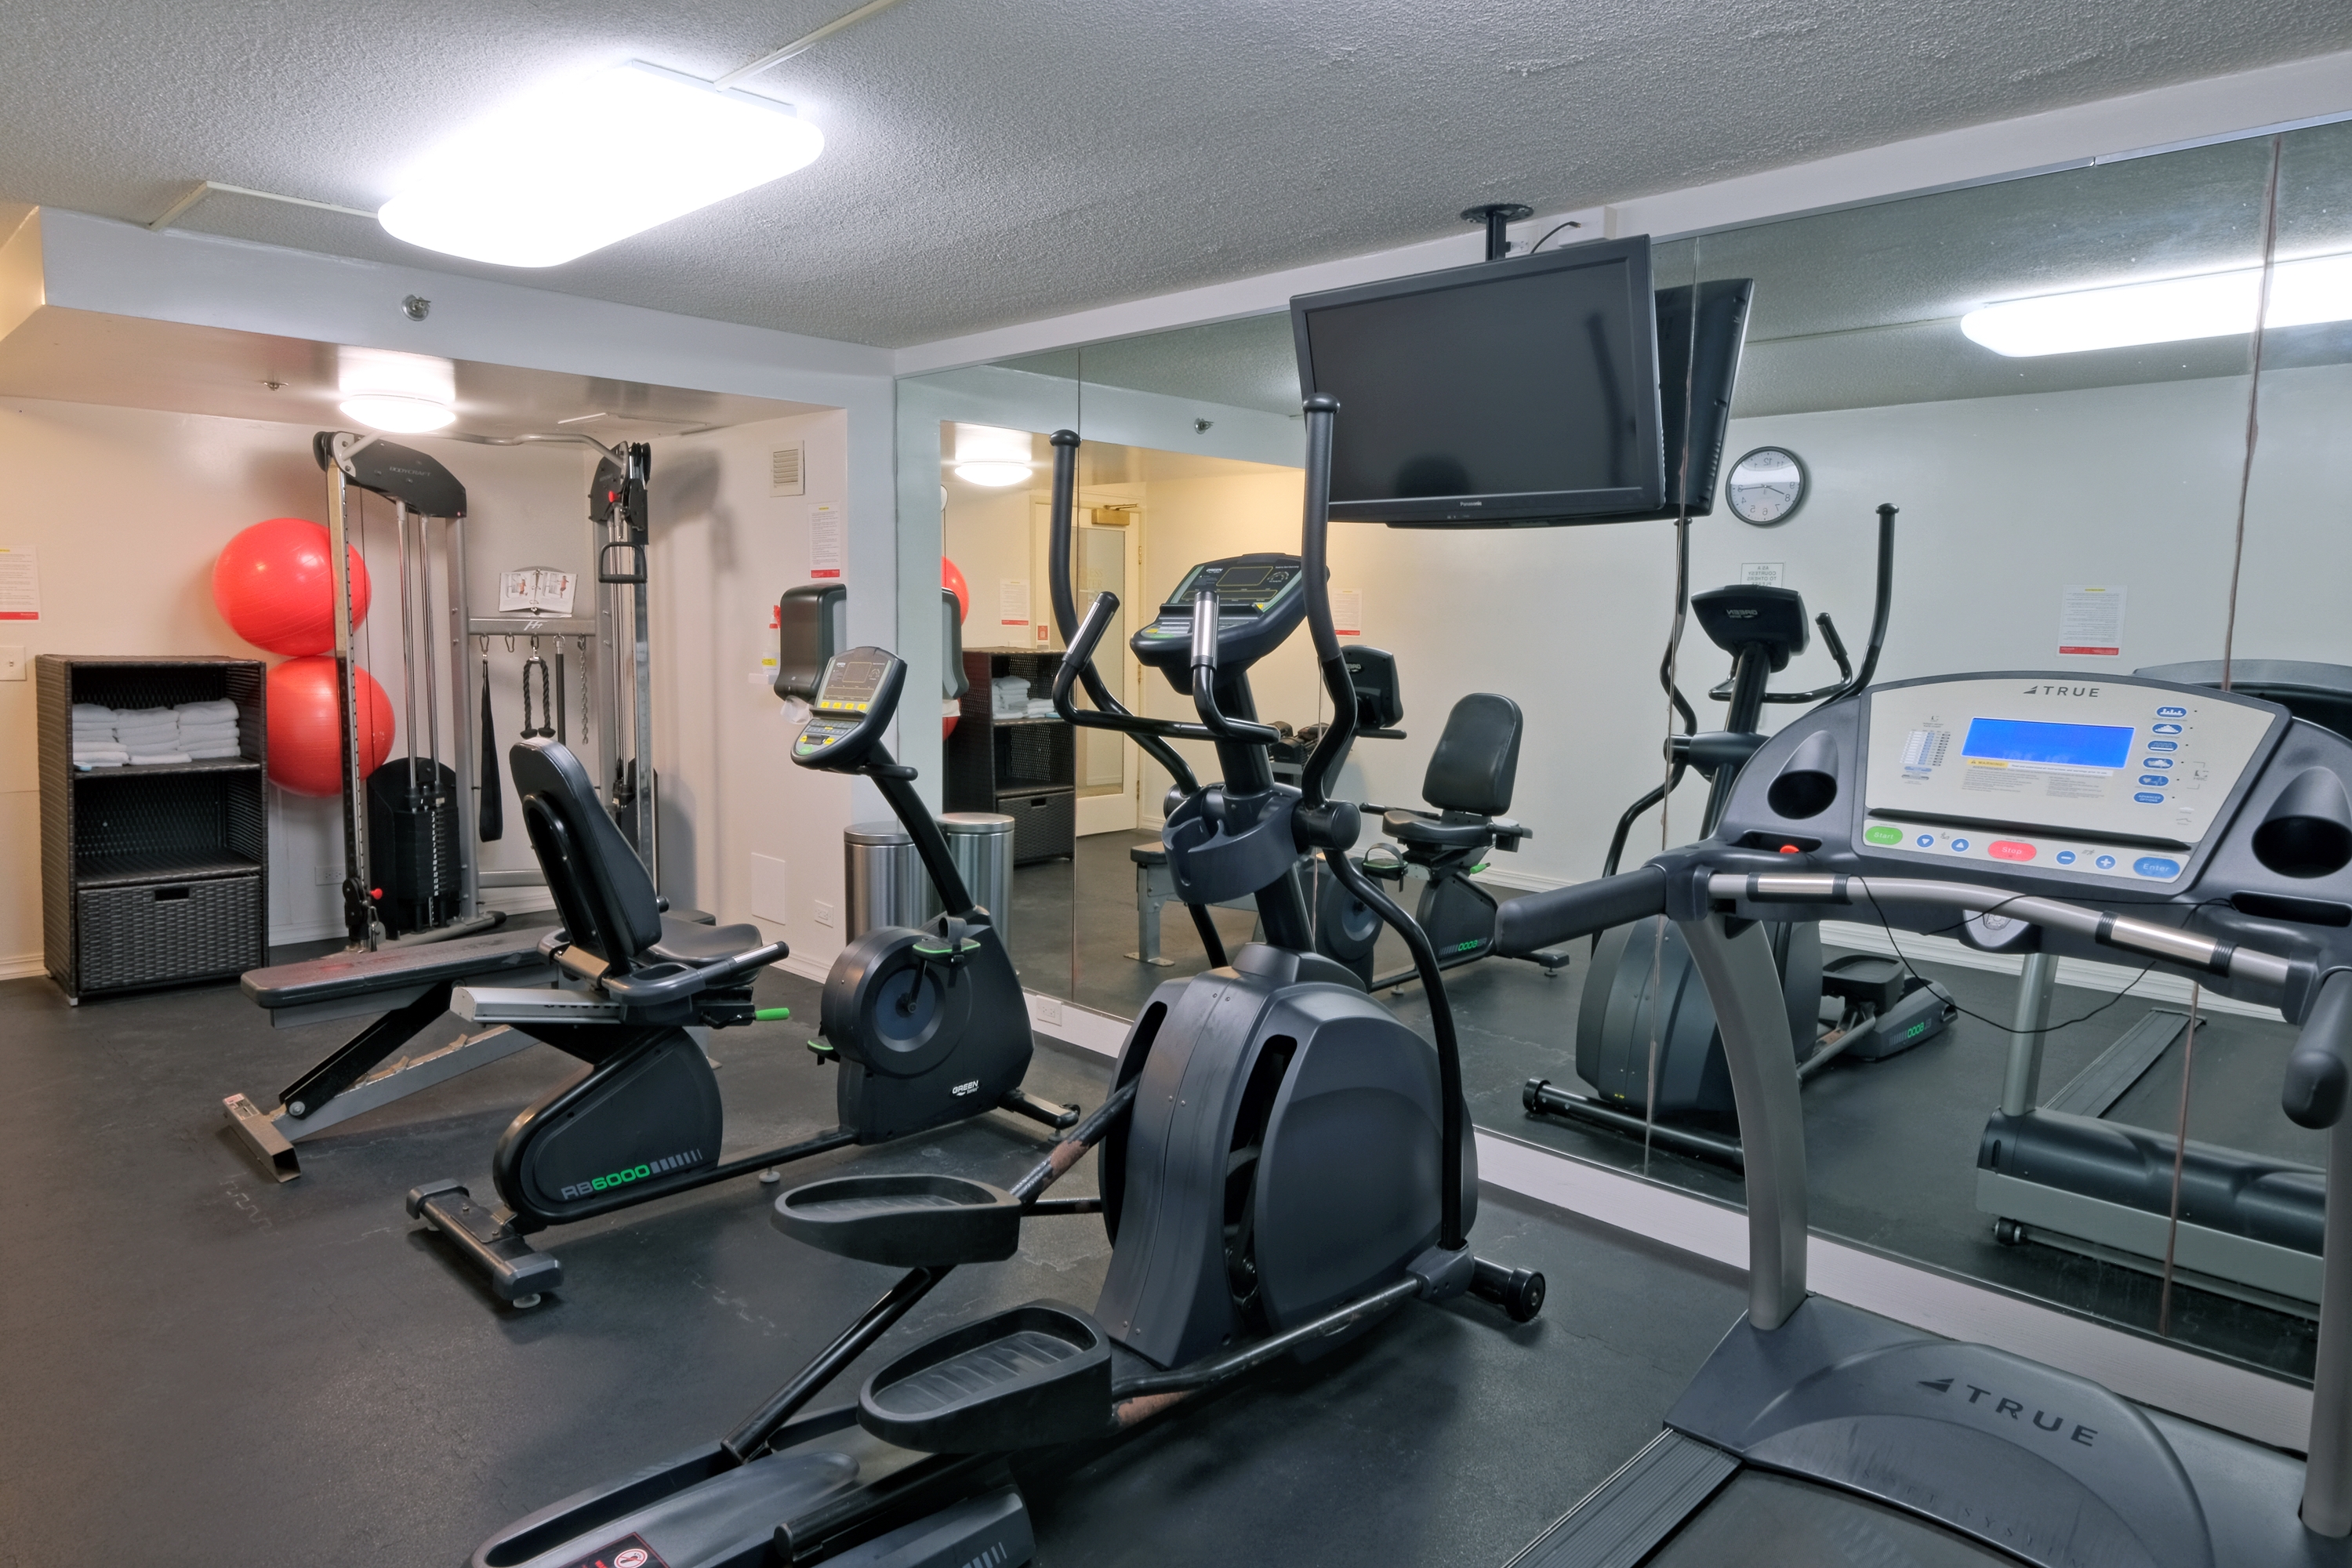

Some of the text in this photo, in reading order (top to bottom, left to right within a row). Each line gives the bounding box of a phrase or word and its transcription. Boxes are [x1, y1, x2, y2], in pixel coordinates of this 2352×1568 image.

[2043, 686, 2100, 697] TRUE
[2143, 863, 2170, 872] Enter
[952, 1080, 978, 1094] GREEN
[561, 1164, 651, 1200] RB6000
[1966, 1385, 2098, 1447] TRUE
